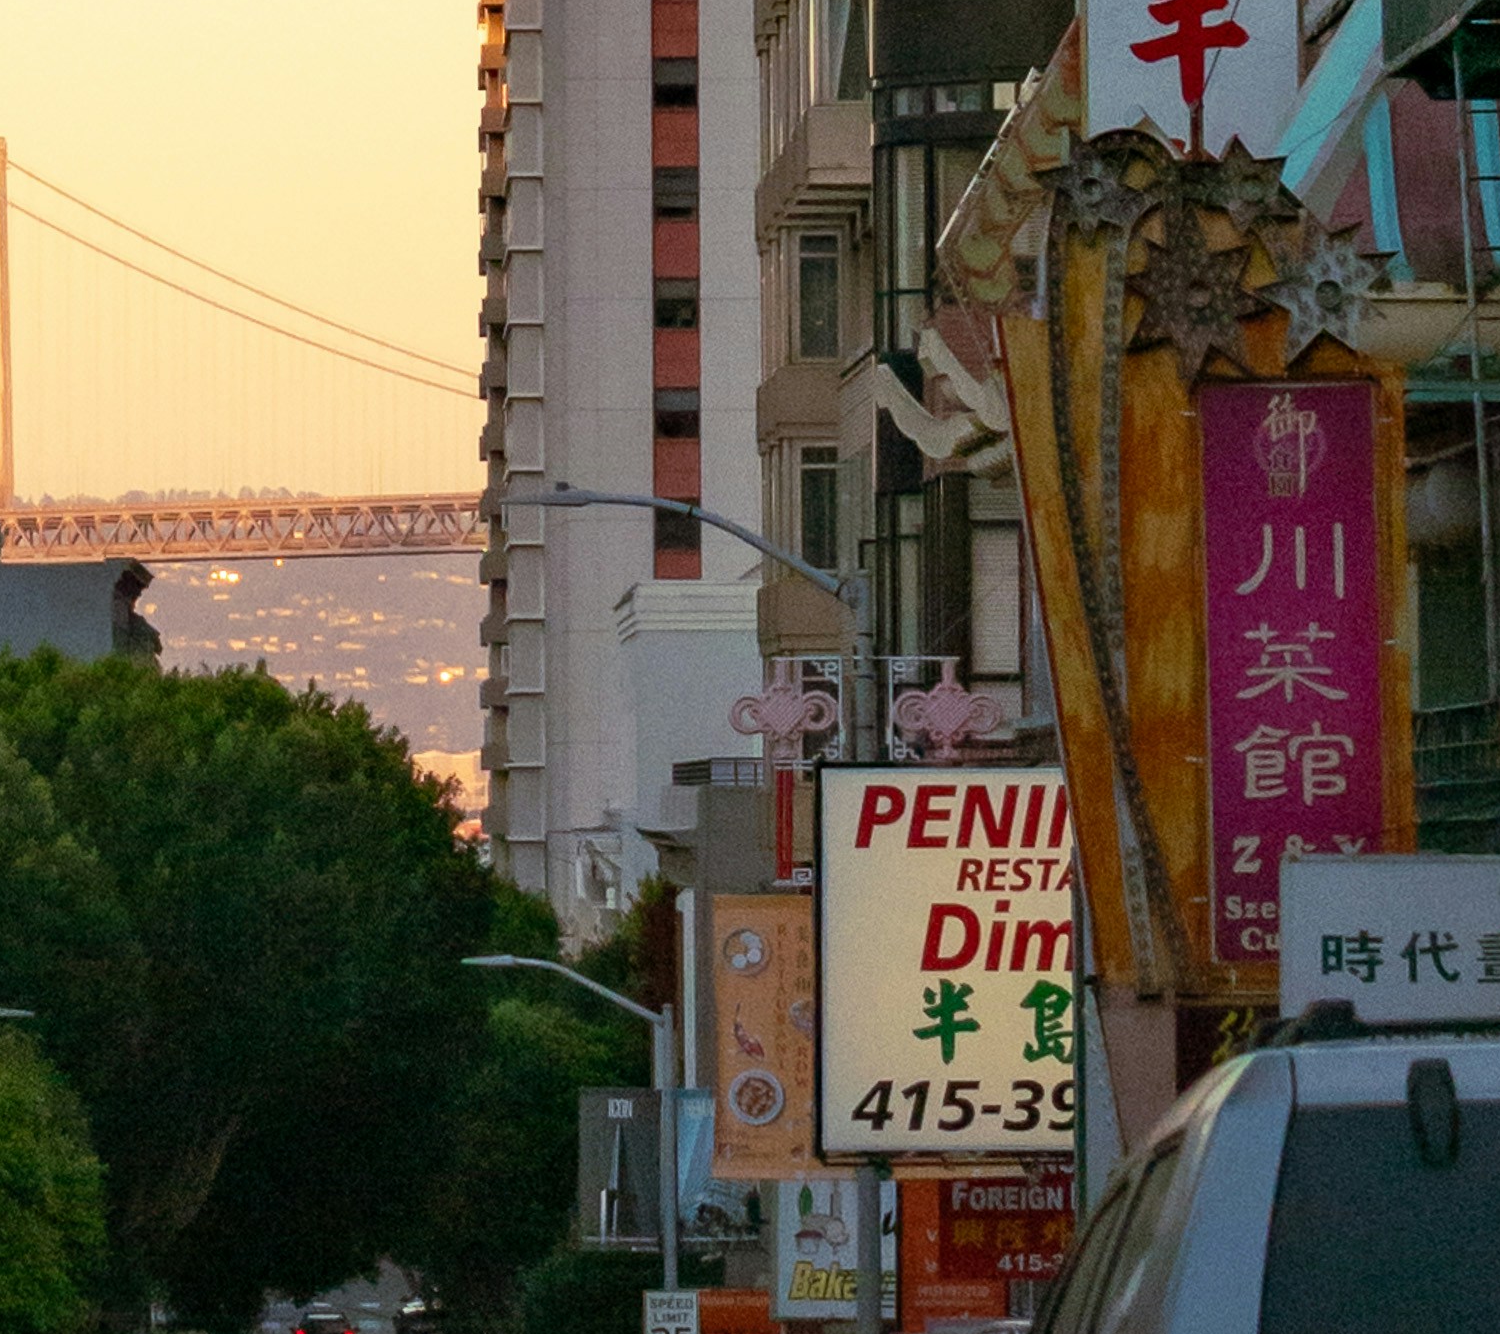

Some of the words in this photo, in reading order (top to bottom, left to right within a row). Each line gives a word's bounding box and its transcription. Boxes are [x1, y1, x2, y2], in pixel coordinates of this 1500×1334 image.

[1234, 521, 1356, 805] 川菜館
[1232, 835, 1263, 874] Z
[1225, 895, 1277, 920] Sze
[1240, 926, 1281, 951] Cu
[951, 1180, 1064, 1211] FOREIGN
[651, 1297, 693, 1310] SPEED
[653, 1312, 691, 1324] LIMIT
